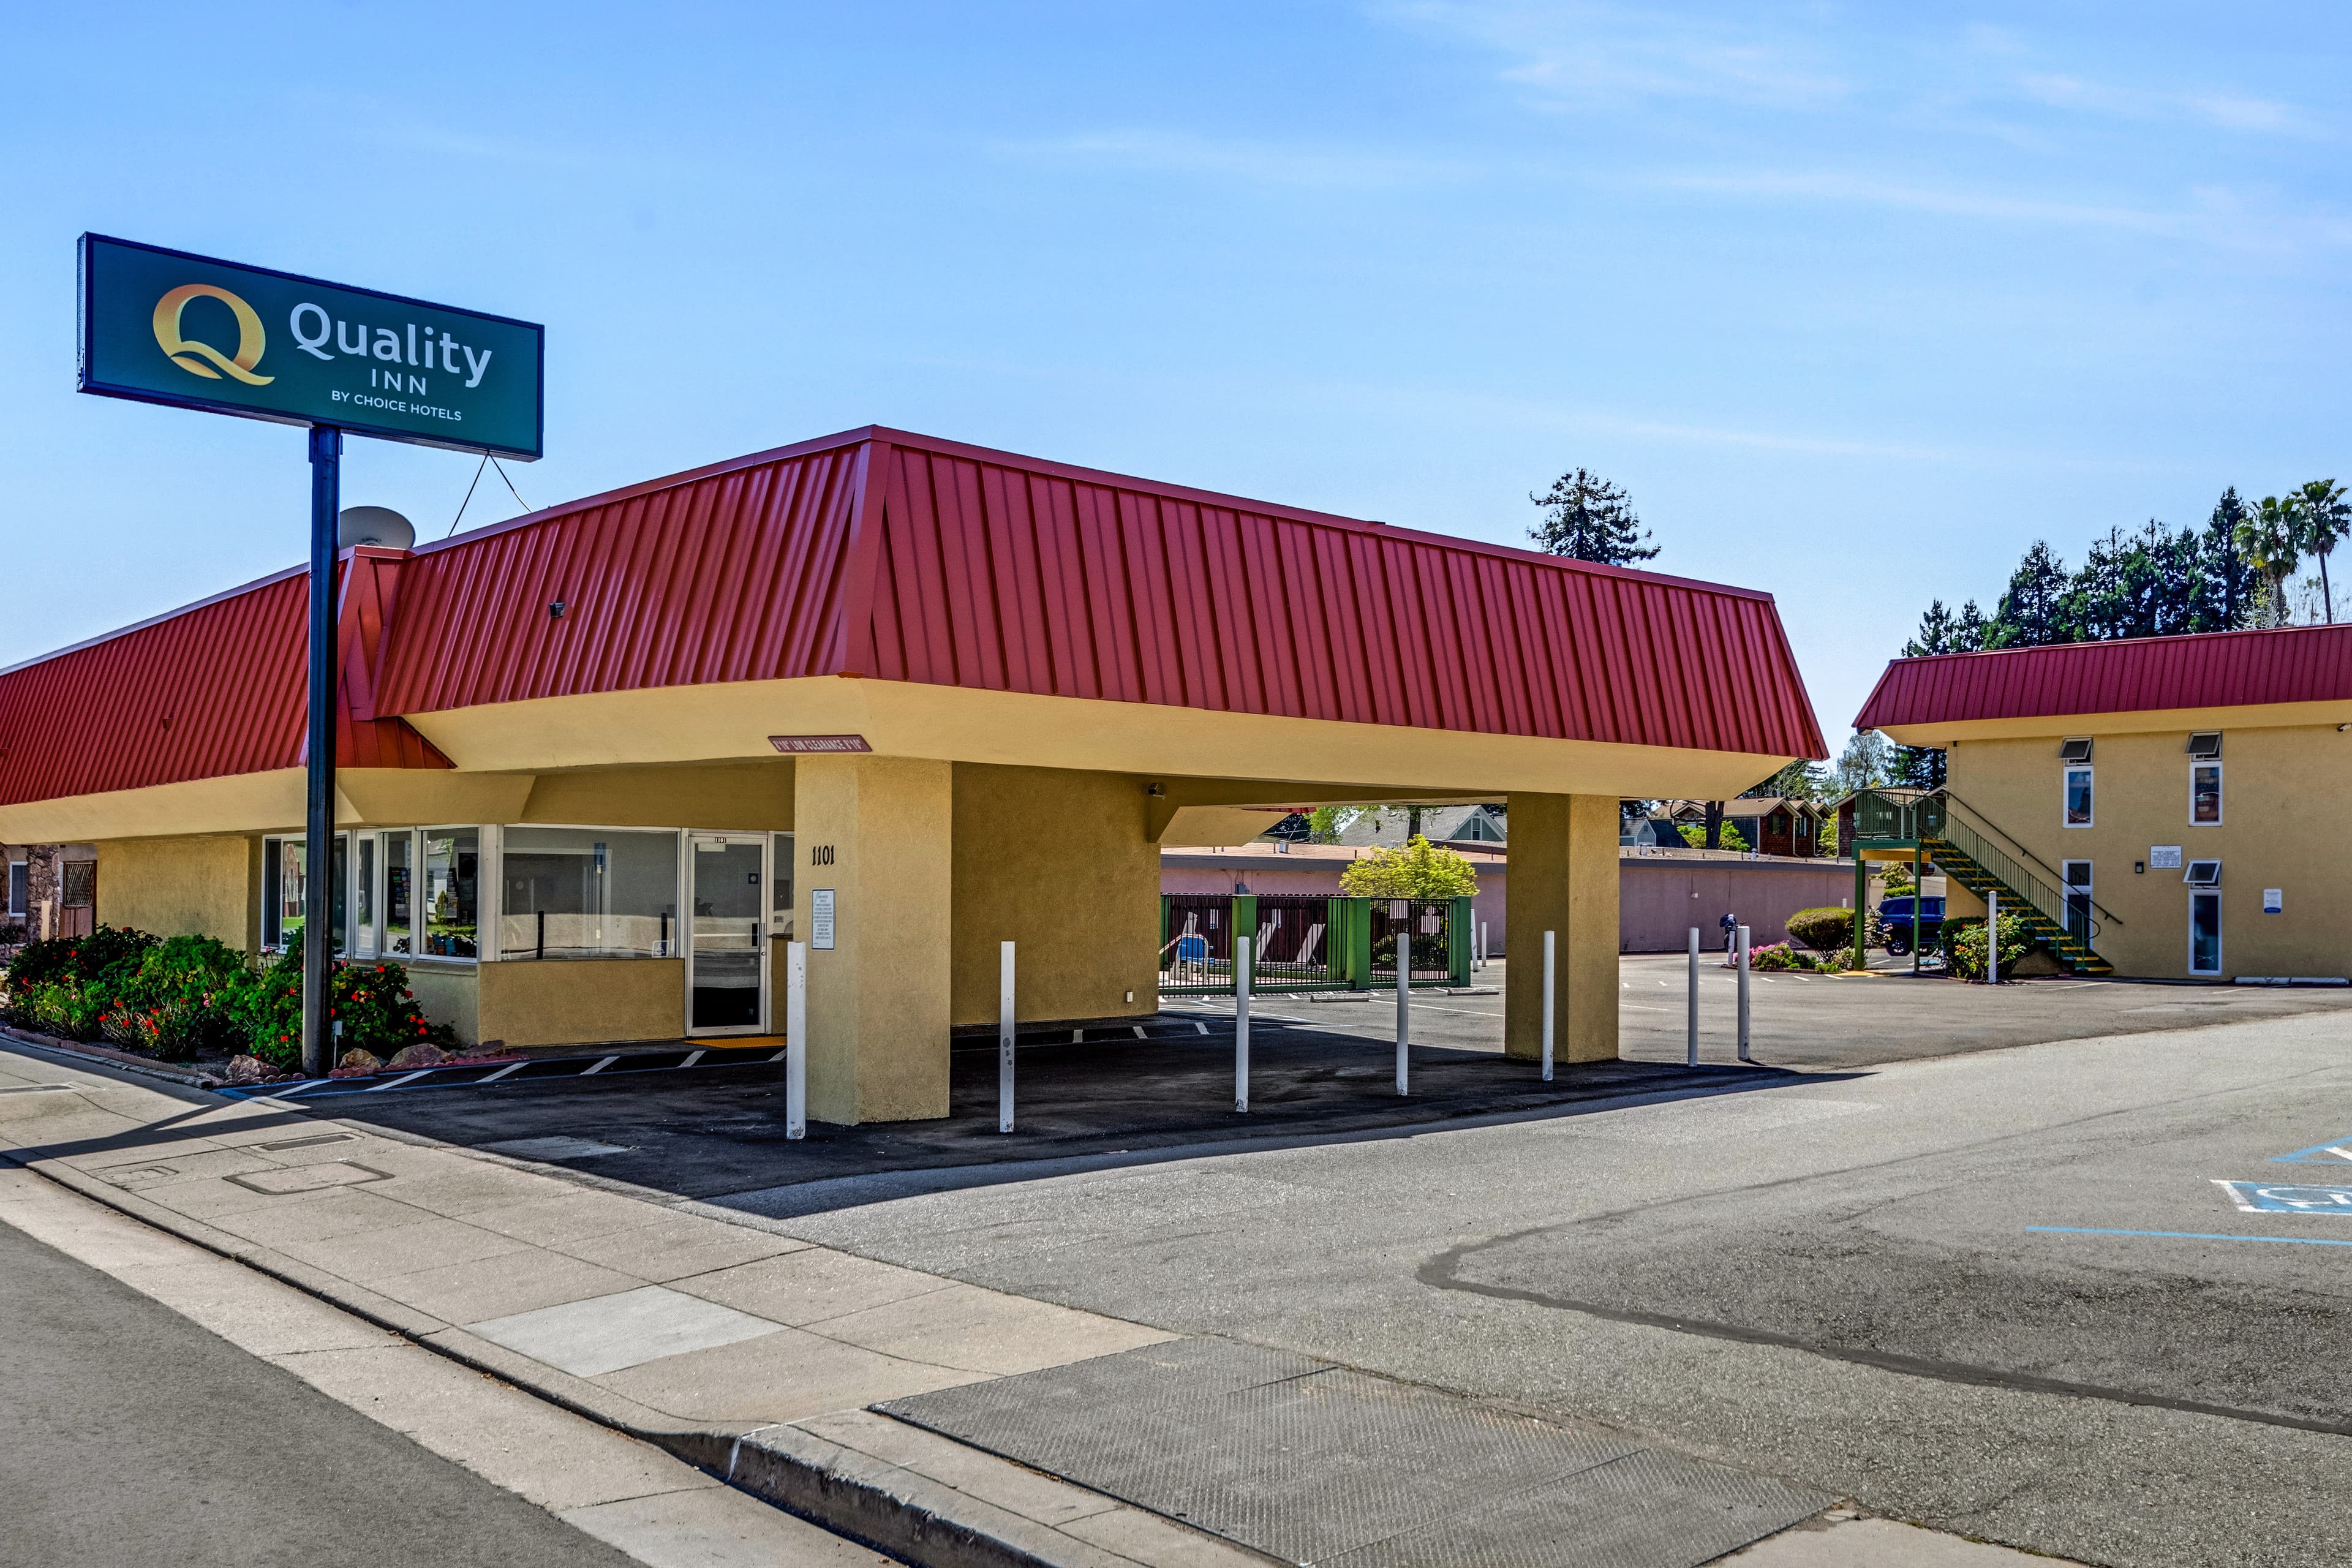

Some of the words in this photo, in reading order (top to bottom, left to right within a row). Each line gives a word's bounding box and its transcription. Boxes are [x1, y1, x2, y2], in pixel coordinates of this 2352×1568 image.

[290, 303, 492, 388] Quality
[372, 369, 426, 396] INN
[331, 390, 350, 402] BY
[354, 394, 406, 412] CHOICE
[410, 403, 462, 421] HOTELS
[789, 740, 807, 750] LOW
[804, 739, 846, 750] CLEARANCE
[812, 845, 834, 865] 1101
